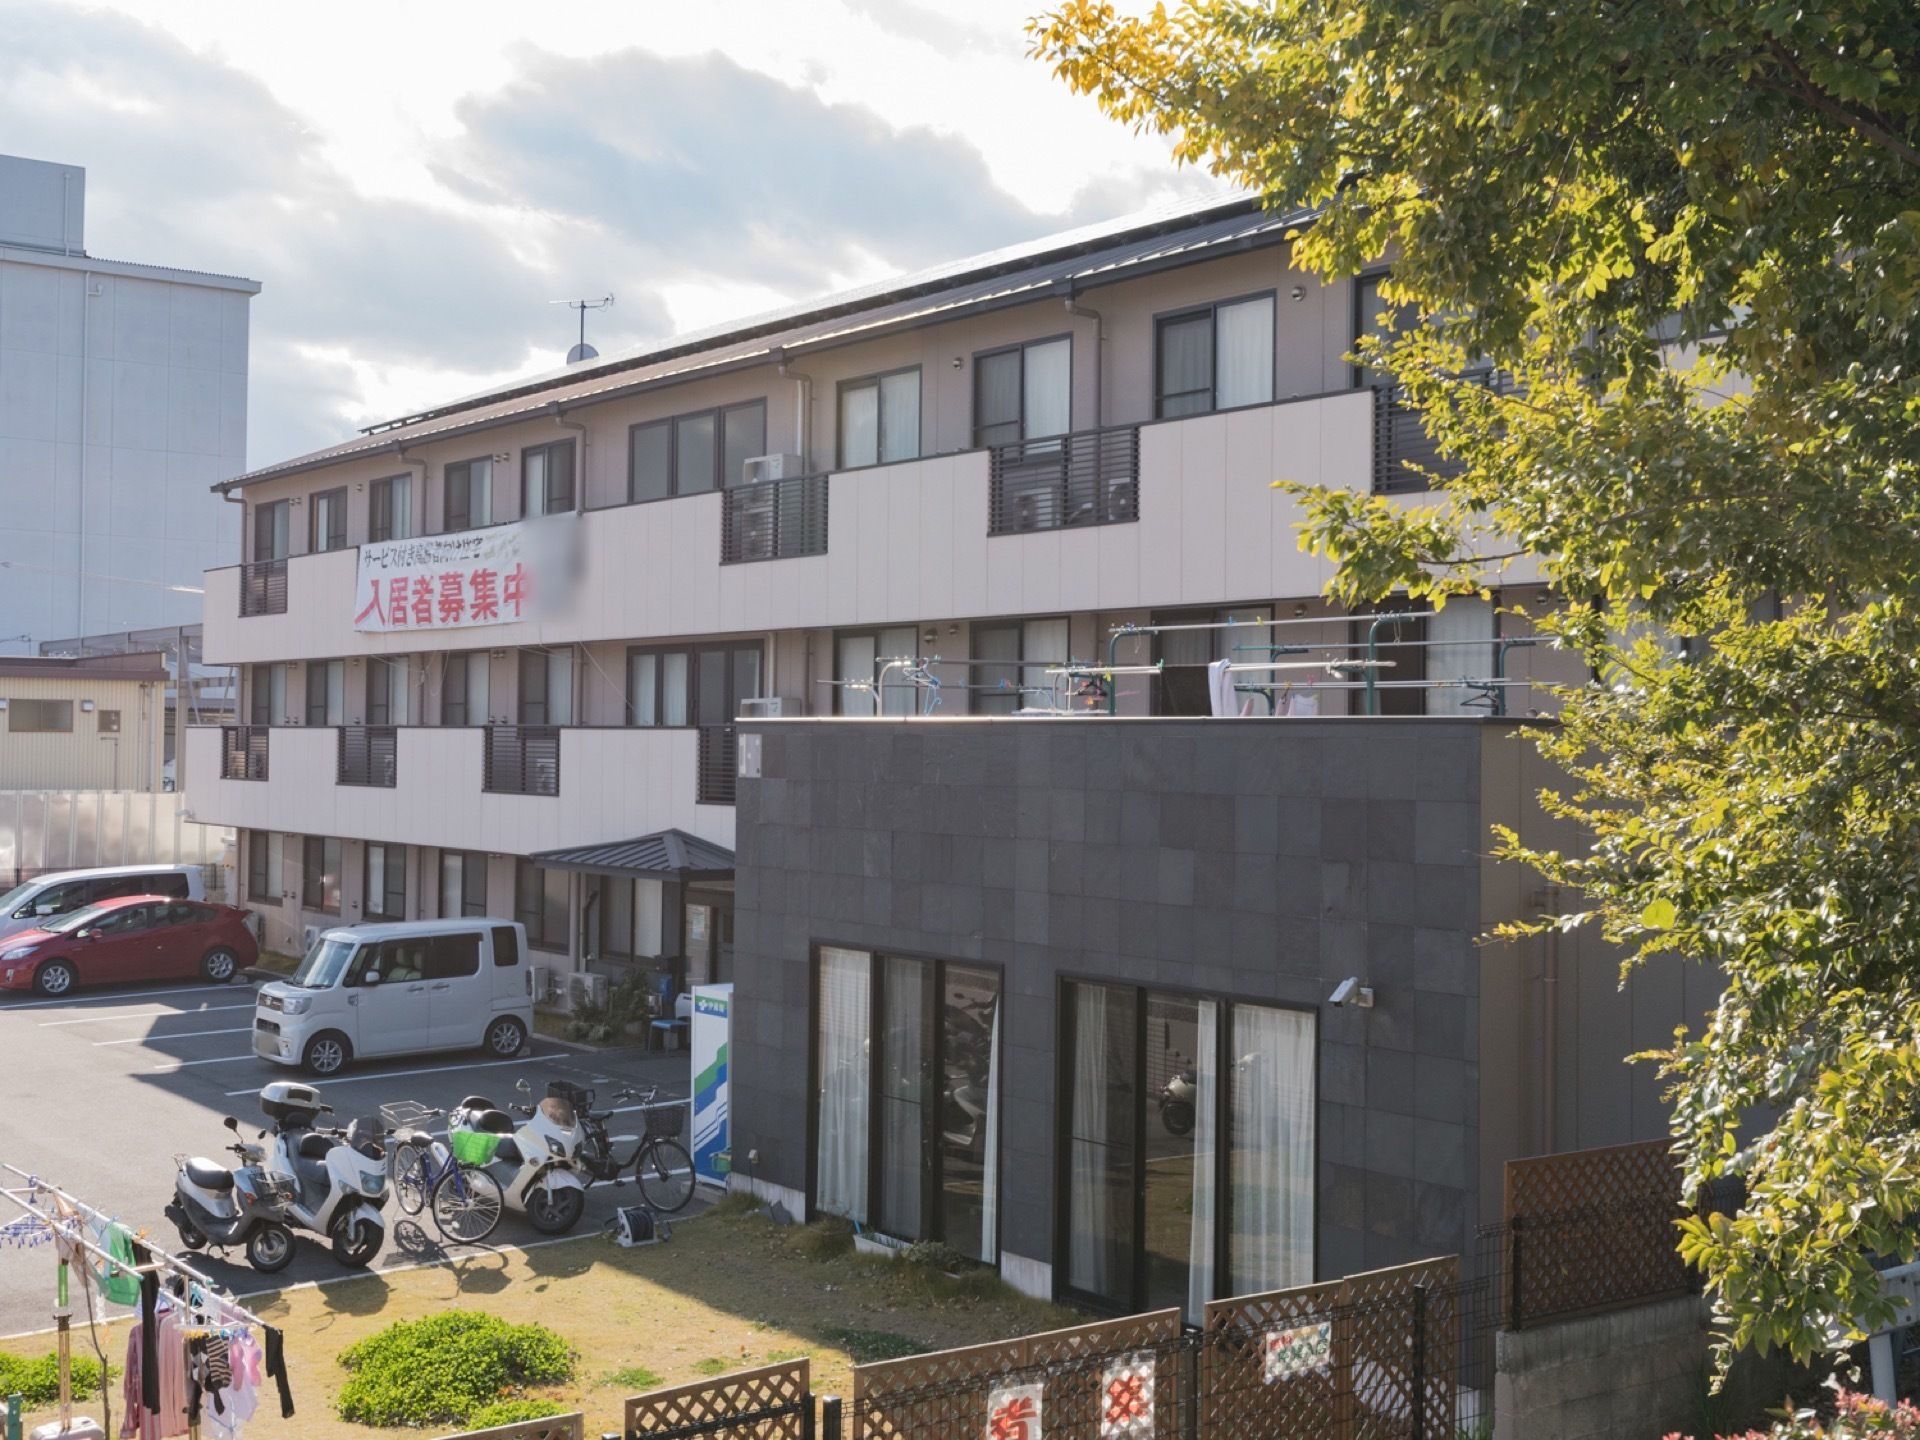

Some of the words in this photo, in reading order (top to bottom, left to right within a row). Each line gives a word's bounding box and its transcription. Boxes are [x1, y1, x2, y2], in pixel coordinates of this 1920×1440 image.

[355, 563, 527, 625] 入居者募集中
